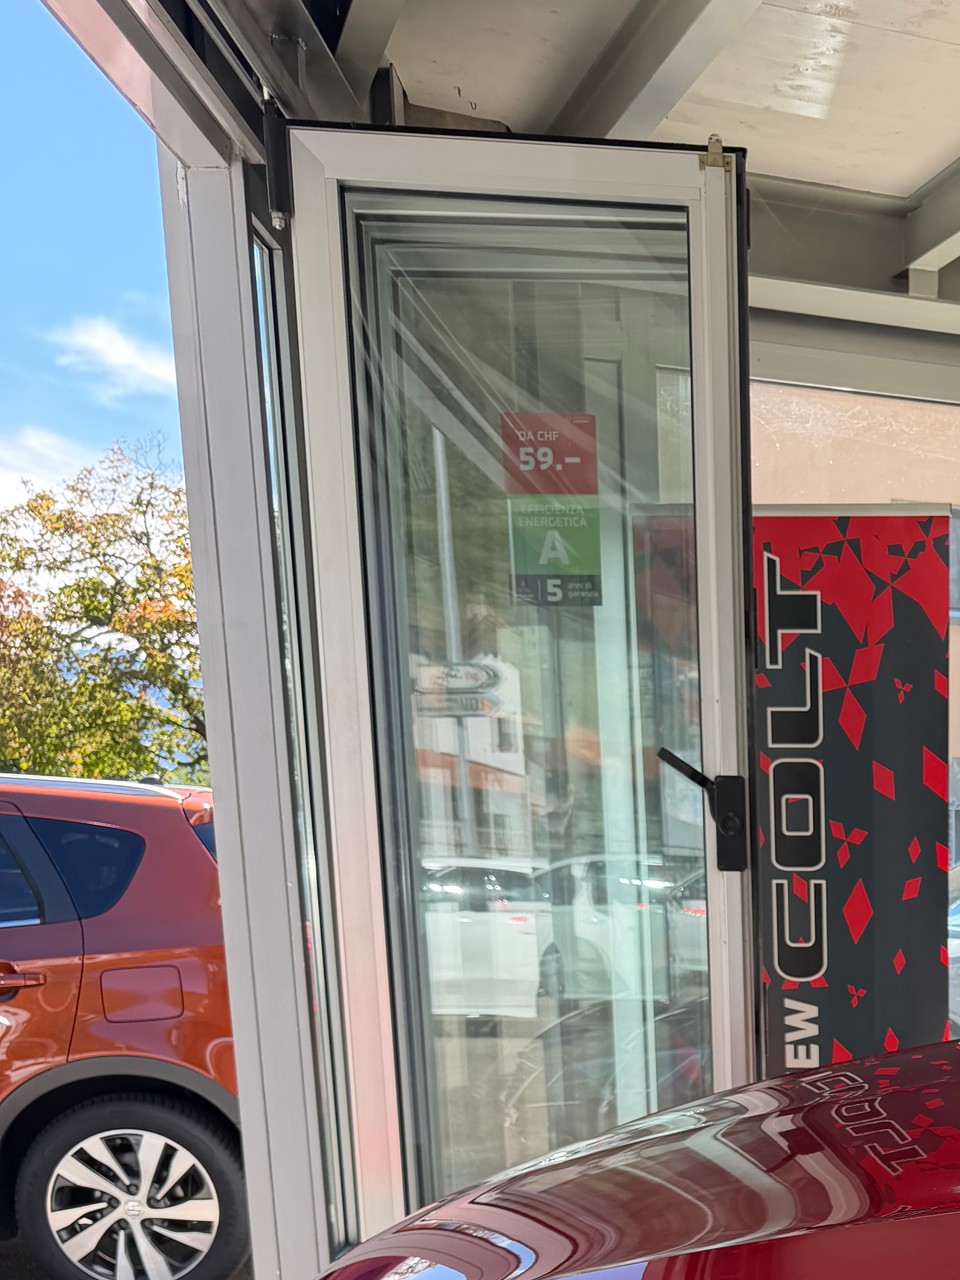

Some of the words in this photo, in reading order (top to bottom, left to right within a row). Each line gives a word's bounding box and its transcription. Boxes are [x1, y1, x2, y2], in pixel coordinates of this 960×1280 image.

[519, 431, 535, 441] DA
[537, 431, 559, 441] CHF
[520, 504, 585, 515] EFFICIENZA
[519, 516, 587, 528] ENERGETICA
[538, 530, 571, 565] A
[546, 578, 563, 602] 5
[764, 551, 827, 981] COLT
[784, 998, 820, 1069] EW
